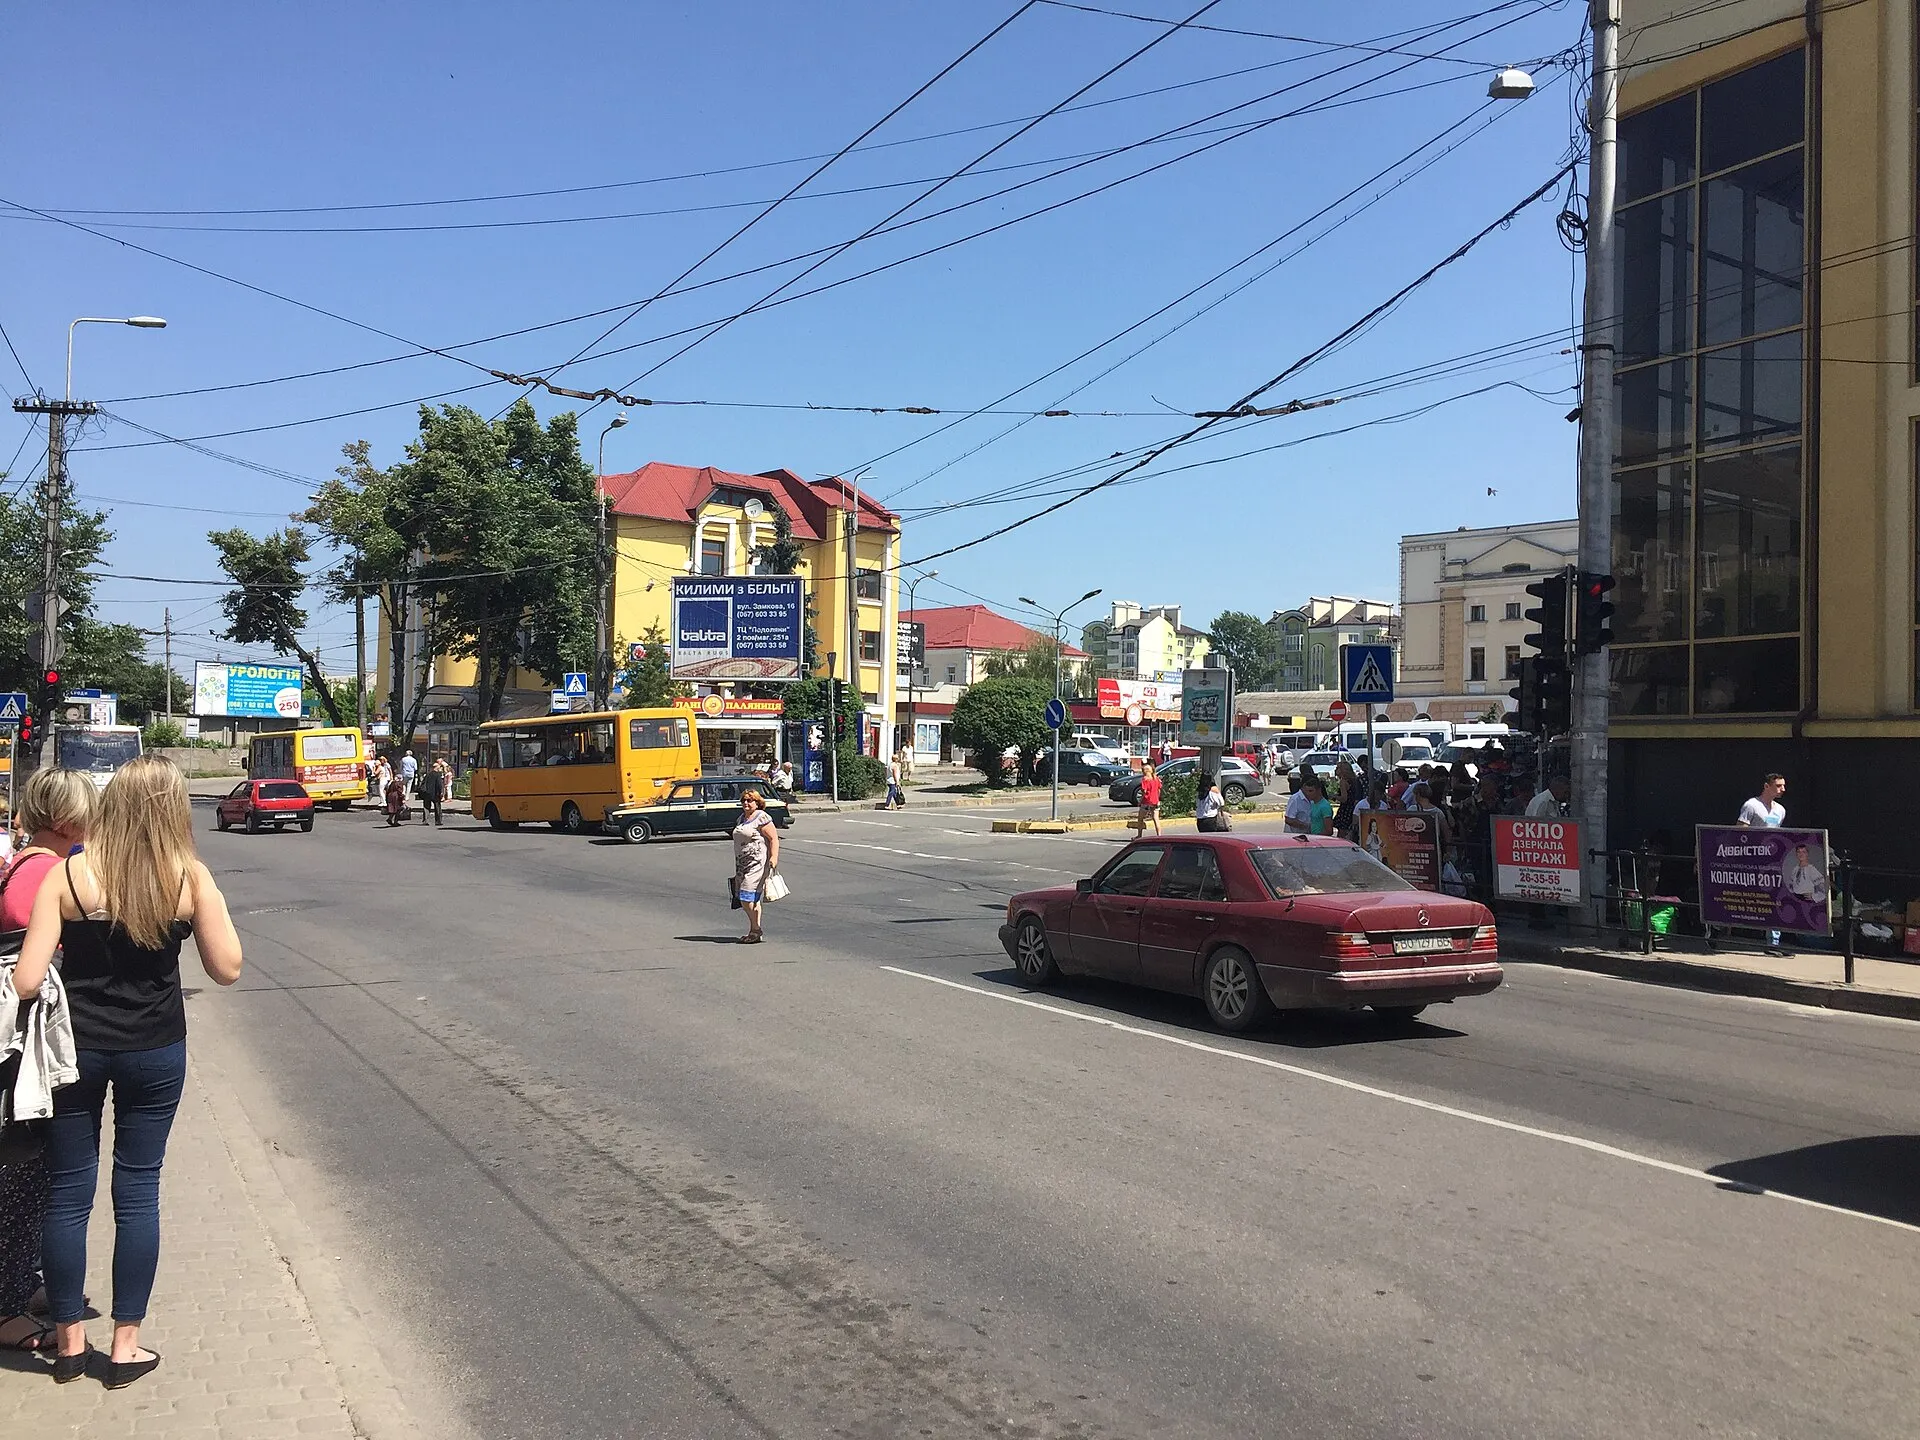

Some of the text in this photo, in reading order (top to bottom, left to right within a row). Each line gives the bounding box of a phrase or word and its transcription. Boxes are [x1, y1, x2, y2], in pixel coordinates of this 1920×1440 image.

[676, 585, 734, 595] КИЛИМИ
[748, 582, 796, 594] БЕЛЬГІЇ
[681, 629, 726, 641] balta
[229, 665, 301, 680] УРОЛОГІЯ
[279, 700, 300, 711] 250
[725, 702, 782, 711] ПАЛЯНИЦЯ
[1512, 822, 1564, 840] СКЛО
[1512, 840, 1564, 851] ДЗЕРКАЛА
[1512, 851, 1567, 865] ВІТРАЖІ
[1519, 872, 1560, 885] 26-35-55
[1710, 870, 1782, 888] КОЛЕКЦІЯ 2017
